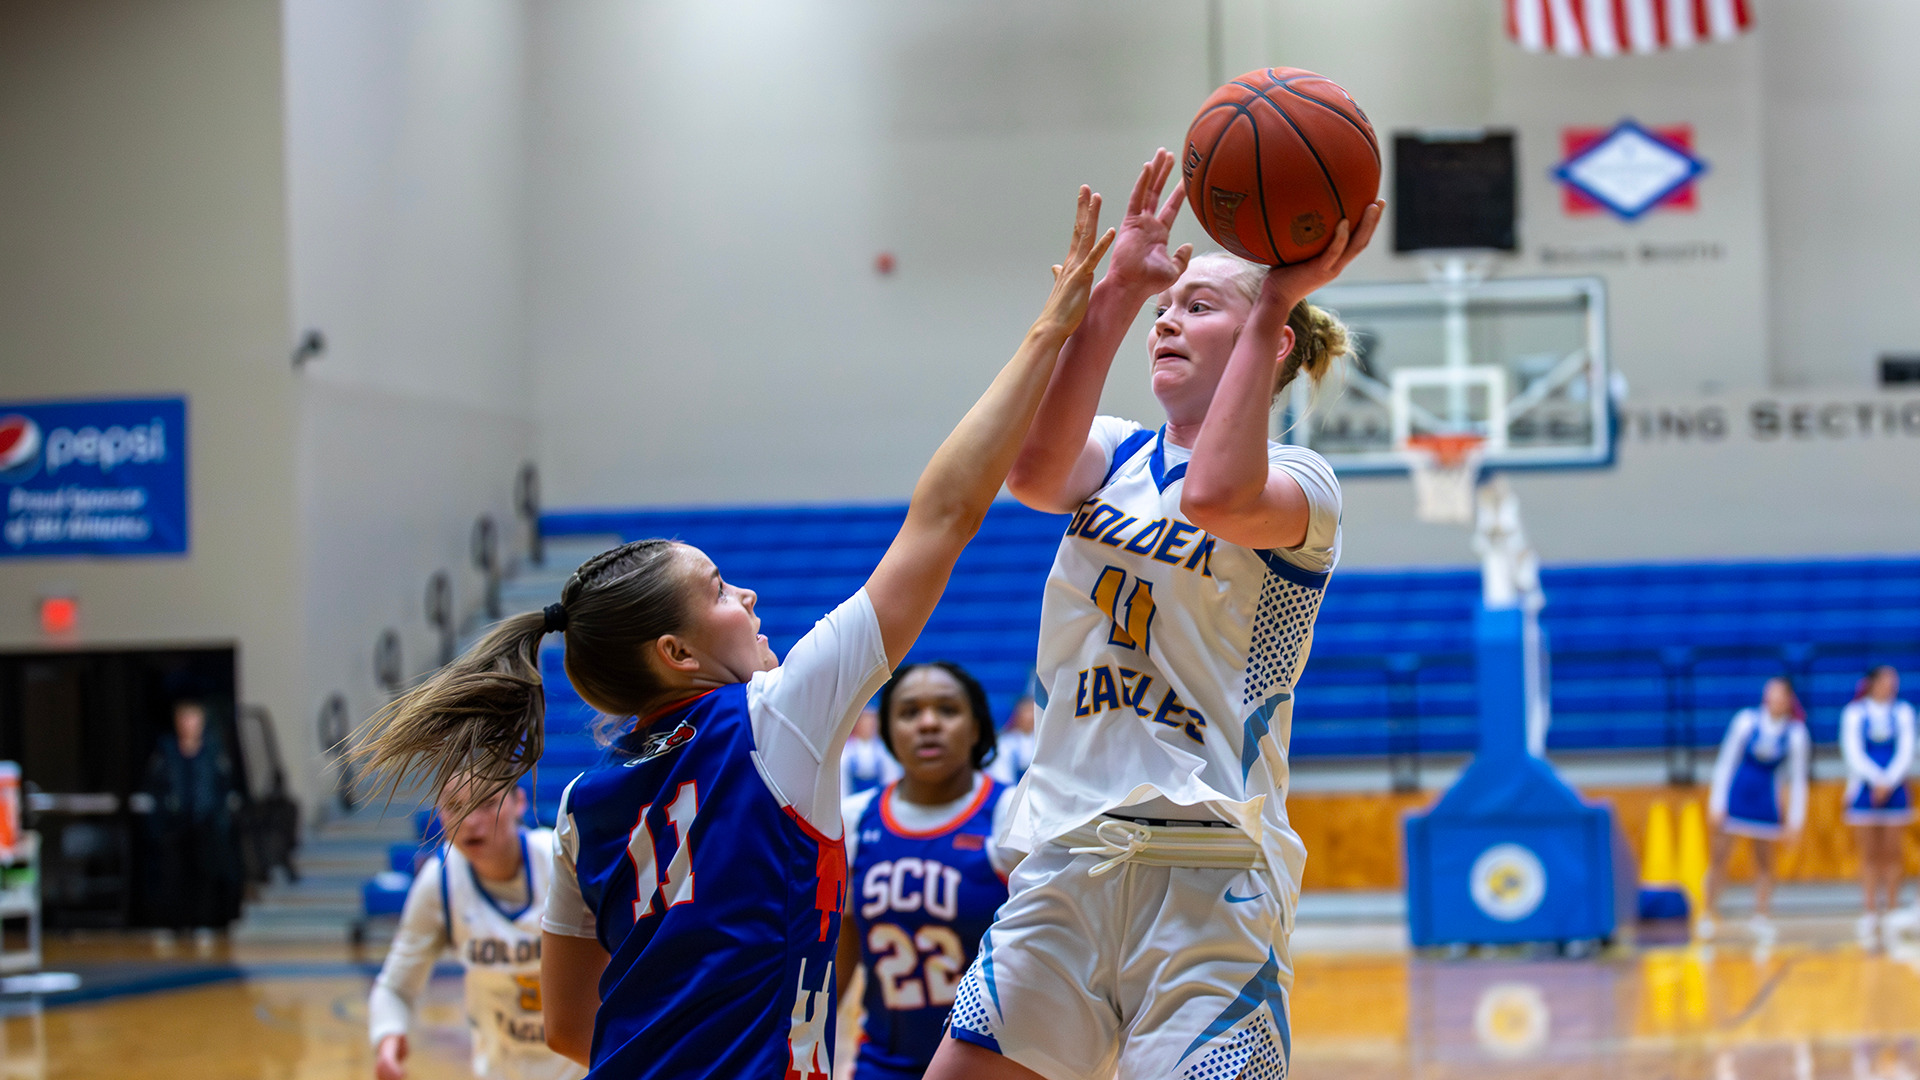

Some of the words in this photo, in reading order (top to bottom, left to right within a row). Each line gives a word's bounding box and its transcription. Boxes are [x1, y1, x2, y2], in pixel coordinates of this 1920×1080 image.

[46, 418, 166, 475] pepsi
[1066, 497, 1216, 578] GOLDEN
[1090, 564, 1157, 657] 11
[627, 779, 699, 924] 11
[861, 857, 962, 921] SCU
[867, 922, 967, 1011] 22
